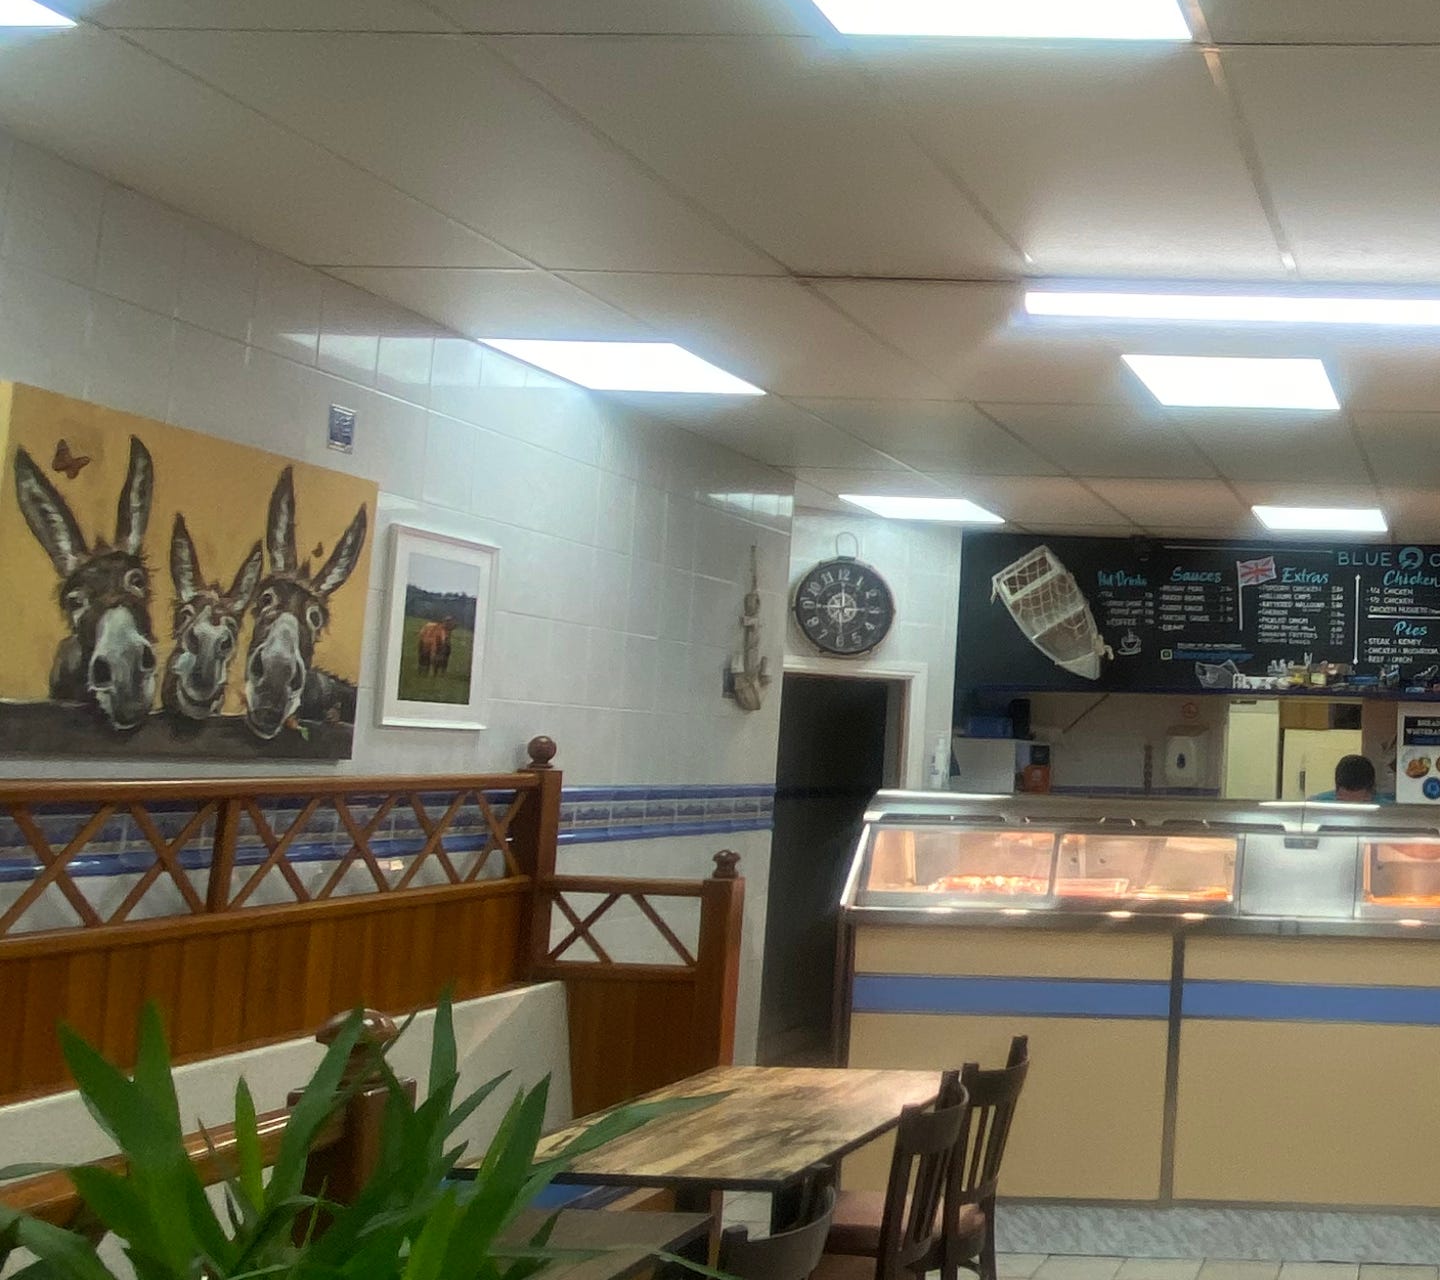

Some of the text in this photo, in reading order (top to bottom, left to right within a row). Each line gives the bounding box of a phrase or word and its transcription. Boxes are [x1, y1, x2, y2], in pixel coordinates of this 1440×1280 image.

[1337, 551, 1392, 567] BLUE
[838, 569, 850, 581] 12
[1170, 566, 1222, 584] Sauces
[1281, 567, 1329, 584] Extras
[1393, 621, 1428, 636] Pies
